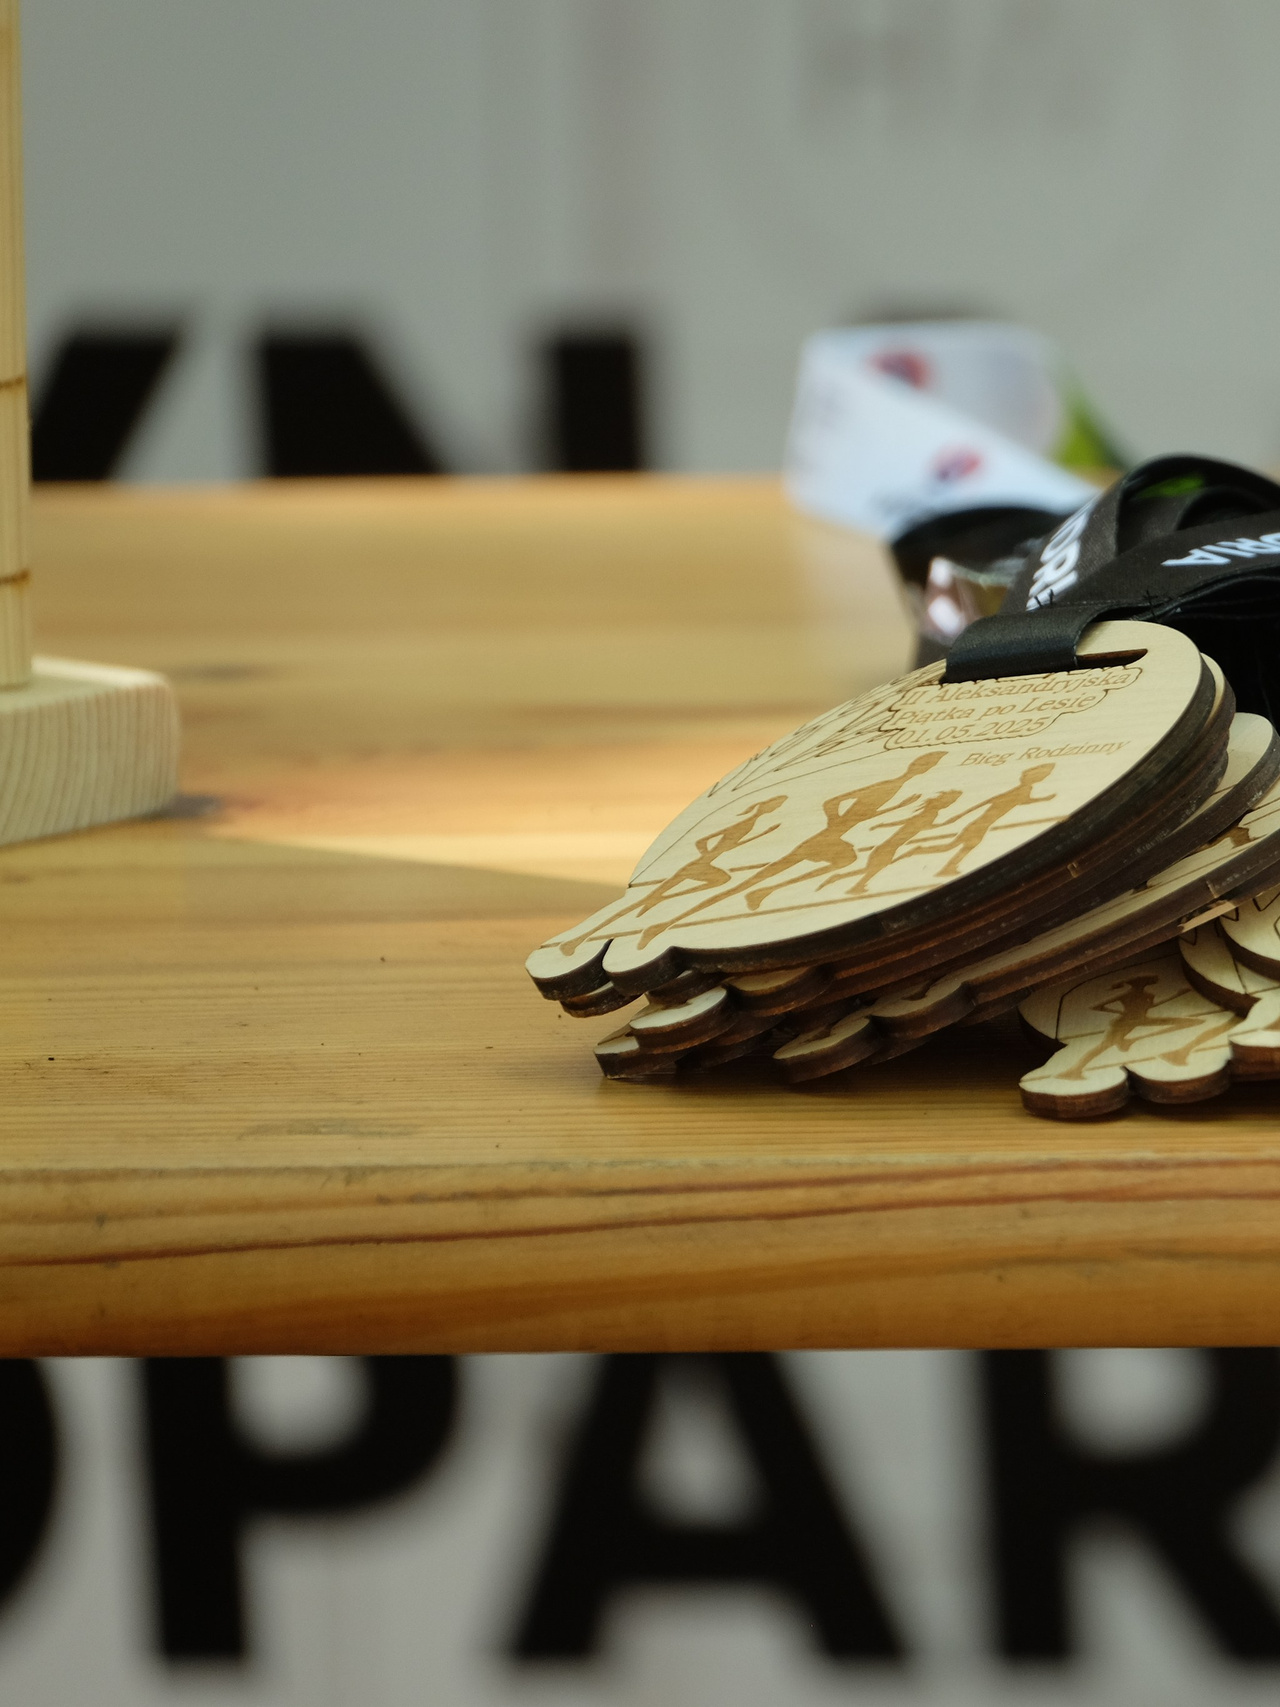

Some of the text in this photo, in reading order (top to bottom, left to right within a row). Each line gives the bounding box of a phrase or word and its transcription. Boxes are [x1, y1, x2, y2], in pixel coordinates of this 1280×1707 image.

[931, 672, 1131, 703] Aleksandryjska
[891, 692, 1097, 728] Piątka po Lesie
[892, 715, 1051, 746] 01.05.2025
[960, 739, 1133, 767] Bieg Rodzinny
